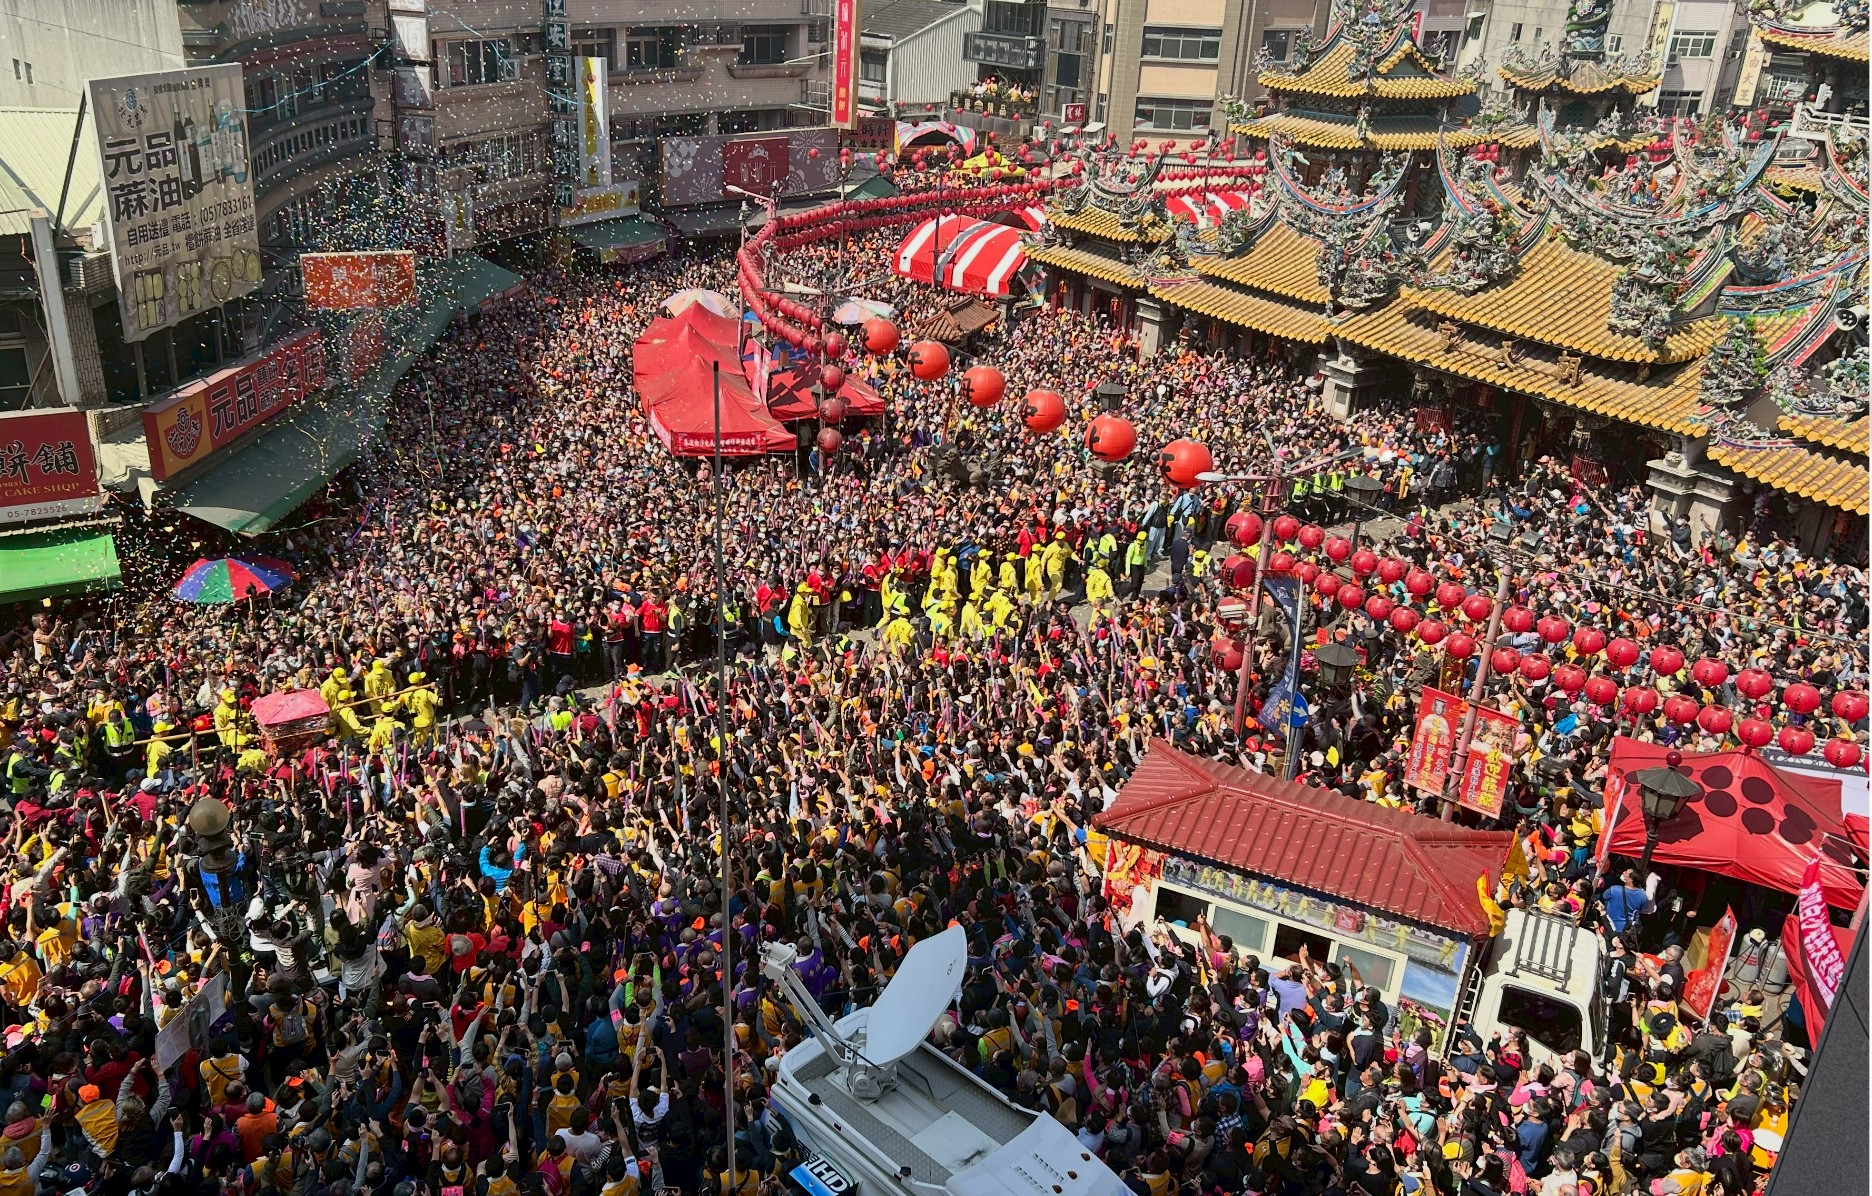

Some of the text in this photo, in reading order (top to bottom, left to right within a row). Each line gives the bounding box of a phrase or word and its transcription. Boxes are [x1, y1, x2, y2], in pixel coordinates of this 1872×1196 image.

[104, 131, 177, 179] 元品
[127, 219, 170, 248] 自用送禮
[200, 194, 252, 227] (05)7833161
[210, 372, 259, 439] 元品
[4, 482, 80, 497] CAKE SHOP
[7, 505, 68, 519] 05-7825526
[810, 1160, 850, 1194] HD
